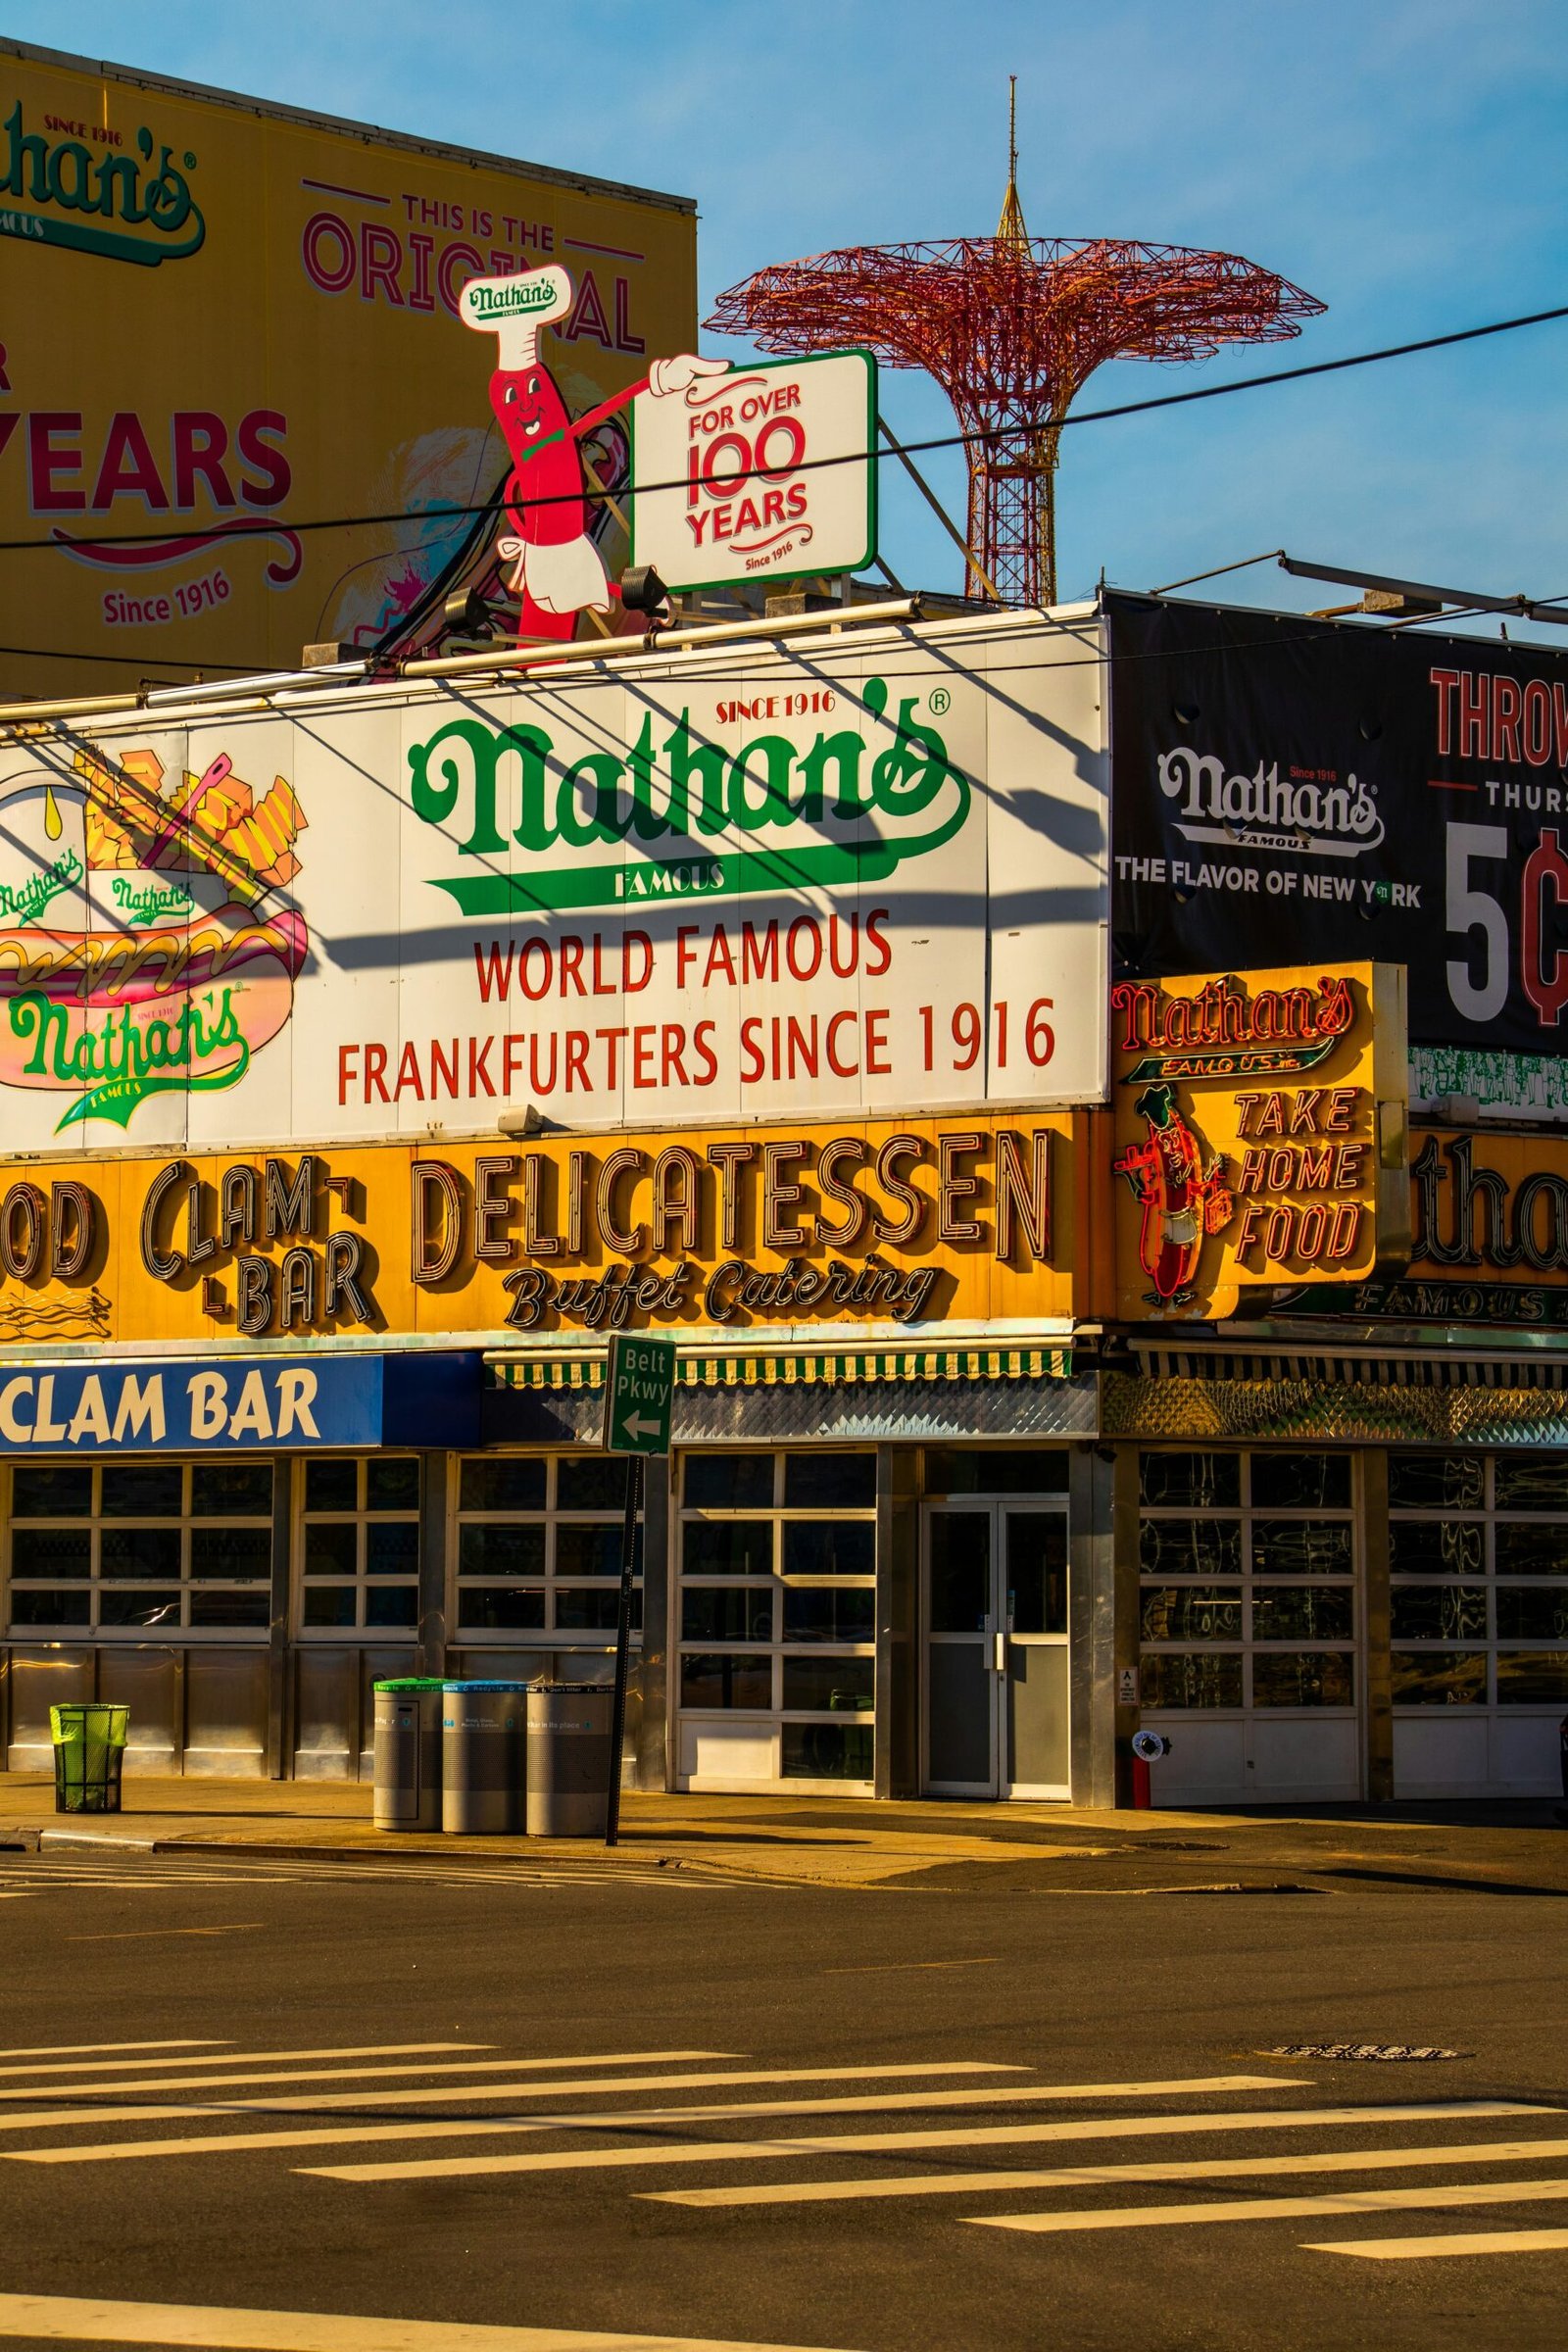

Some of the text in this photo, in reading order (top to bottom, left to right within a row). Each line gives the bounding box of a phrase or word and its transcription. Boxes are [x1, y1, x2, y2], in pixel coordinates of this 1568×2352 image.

[44, 115, 123, 147] SINCE 1916
[402, 194, 555, 253] THIS IS THE
[469, 277, 555, 312] Nathan's
[688, 383, 802, 440] FOR OVER
[688, 416, 806, 509] 100
[685, 482, 808, 548] YEARS
[746, 542, 794, 571] Since 1916
[104, 570, 230, 625] Since 1916
[716, 689, 837, 724] SINCE 1916
[407, 677, 951, 858] Nathan's
[1157, 747, 1377, 835] Nathan's
[1289, 765, 1338, 783] Since 1916
[1485, 781, 1568, 813] THUR
[1237, 834, 1311, 851] FAMOUS
[112, 877, 193, 910] Nathan's
[614, 862, 725, 899] FAMOUS
[1115, 856, 1165, 883] THE
[1171, 859, 1260, 893] FLAVOR
[1266, 870, 1298, 896] OF
[1303, 873, 1356, 903] NEW
[474, 907, 893, 1004] WORLD FAMOUS
[8, 988, 240, 1082] Nathan's
[1112, 975, 1354, 1051] Nathan's
[337, 998, 1055, 1106] FRANKFURTERS SINCE 1916
[1160, 1054, 1274, 1076] FAMOUS
[89, 1081, 143, 1108] FAMOUS
[1234, 1087, 1360, 1137] TAKE
[1238, 1144, 1369, 1194] HOME
[140, 1155, 315, 1282] CLAM
[411, 1128, 1054, 1285] DELICATESSEN
[1234, 1202, 1363, 1264] FOOD
[237, 1230, 374, 1334] BAR
[502, 1252, 941, 1329] Buffet Catering
[1353, 1284, 1546, 1321] FAMOUS
[625, 1348, 666, 1375] Belt
[0, 1367, 321, 1446] CLAM BAR
[617, 1375, 669, 1407] Pkwy
